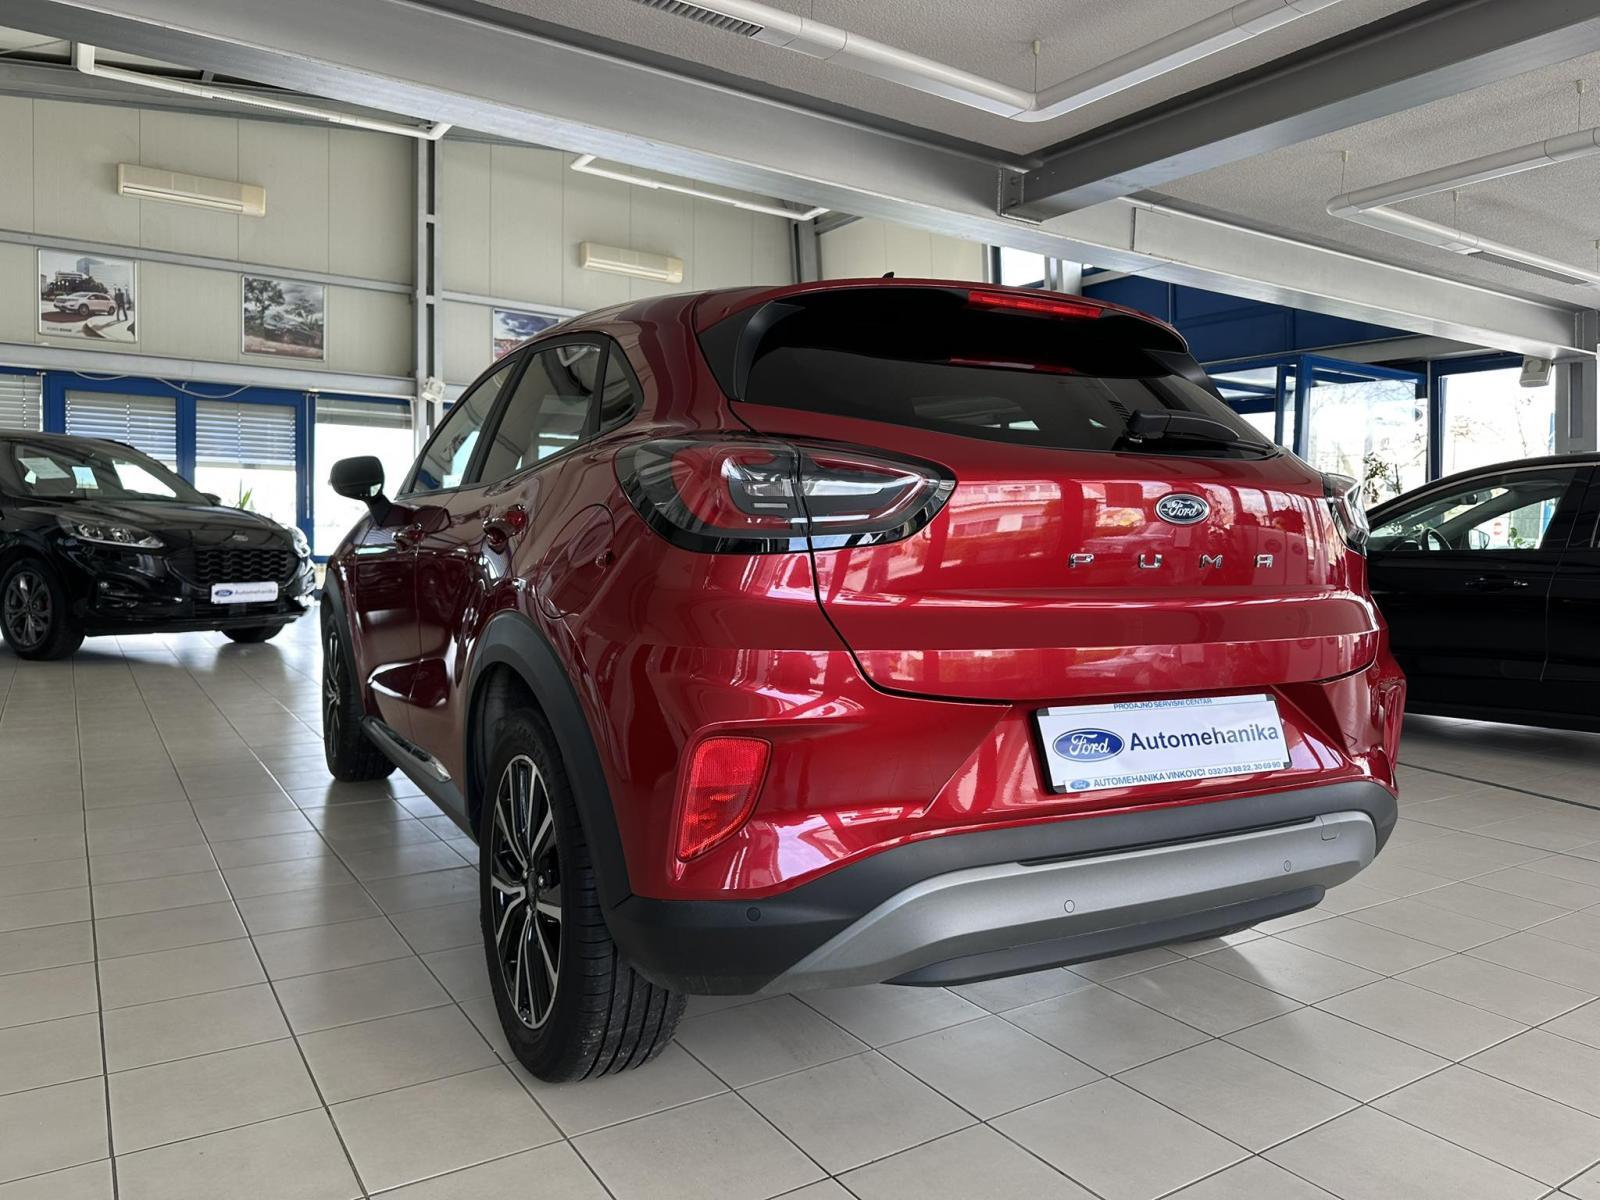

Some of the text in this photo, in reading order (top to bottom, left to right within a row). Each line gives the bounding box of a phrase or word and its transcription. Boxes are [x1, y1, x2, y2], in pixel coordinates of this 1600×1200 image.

[1069, 553, 1273, 569] PUMA
[1154, 700, 1185, 708] SERVISNI
[1185, 698, 1213, 706] CENTAR
[1068, 723, 1279, 756] Ford Automehanika
[1093, 773, 1165, 787] AUTOMEHANIKA
[1167, 768, 1206, 779] VINKOVCI
